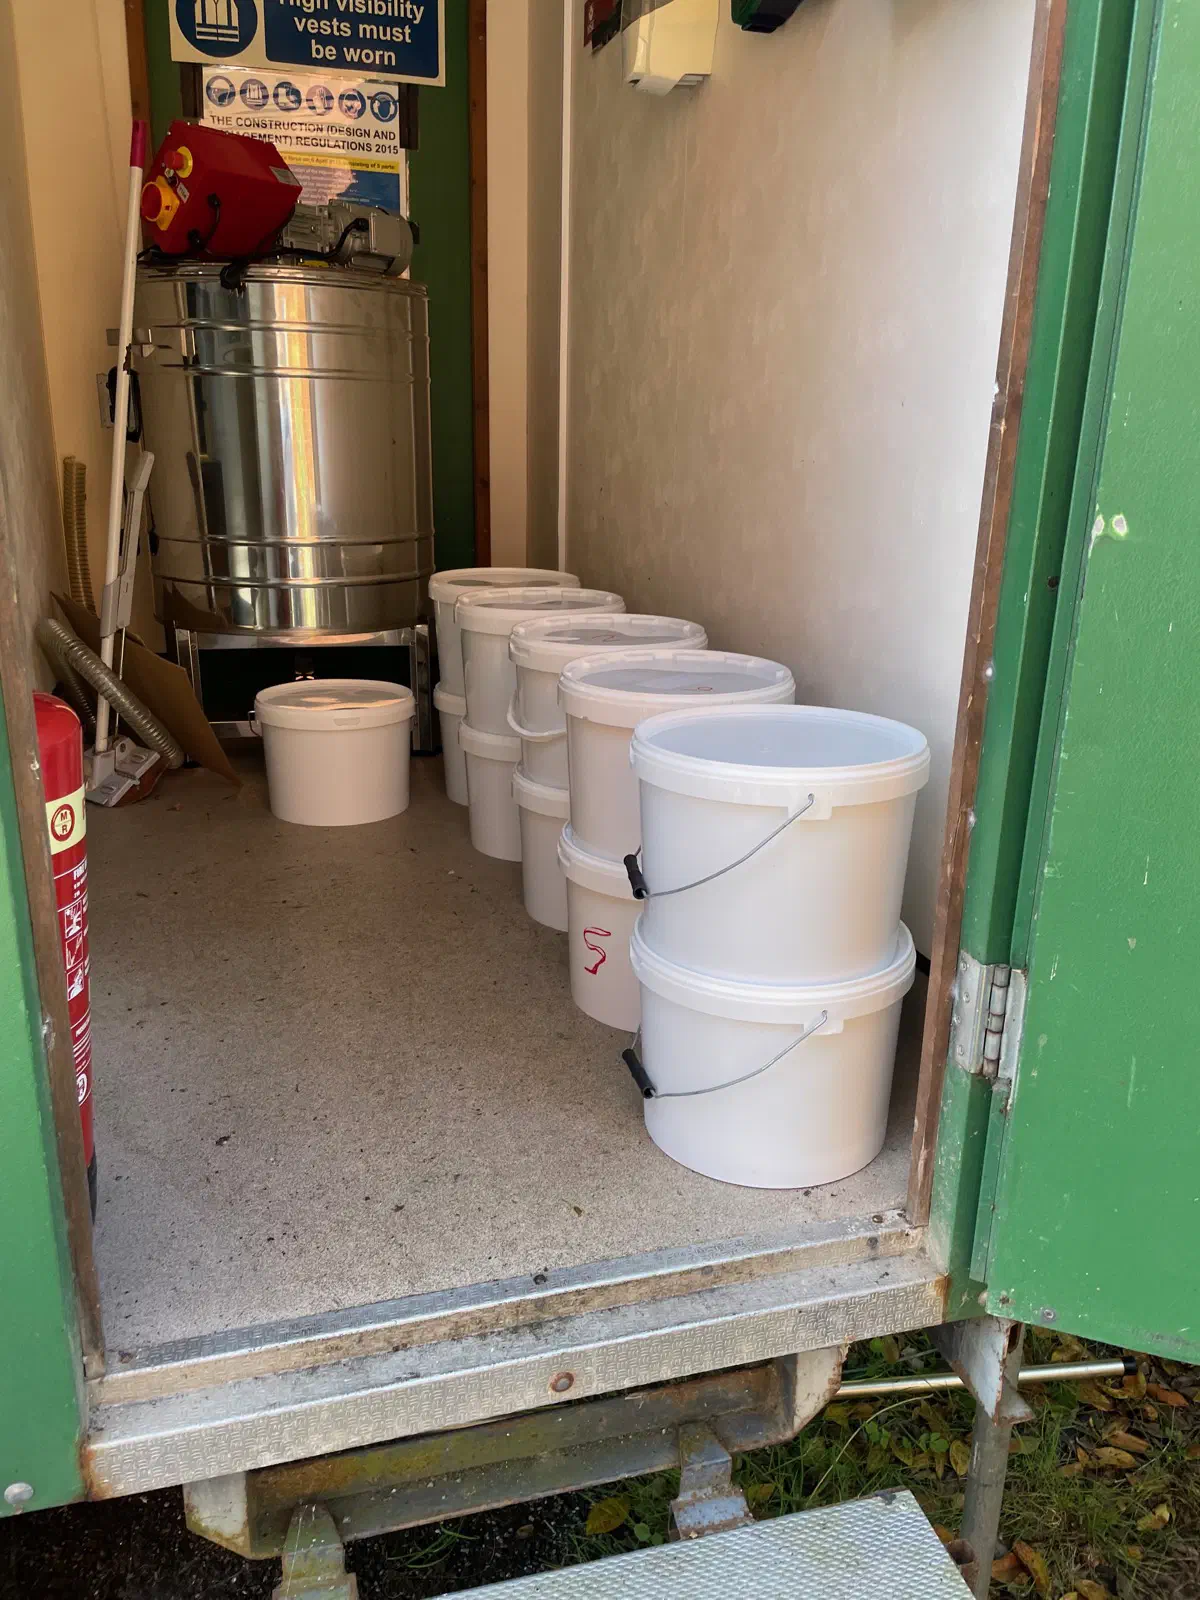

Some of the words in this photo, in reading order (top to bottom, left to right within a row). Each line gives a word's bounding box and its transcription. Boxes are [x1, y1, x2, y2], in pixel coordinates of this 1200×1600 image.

[336, 0, 424, 24] visibility
[293, 16, 351, 37] vests
[358, 23, 412, 43] must
[311, 39, 337, 61] be
[343, 47, 396, 66] worn
[210, 115, 233, 126] THE
[236, 117, 324, 133] CONSTRUCTION
[326, 125, 371, 138] (DESIGN
[373, 130, 396, 141] AND
[295, 136, 373, 152] REGULATIONS
[375, 144, 399, 155] 2015
